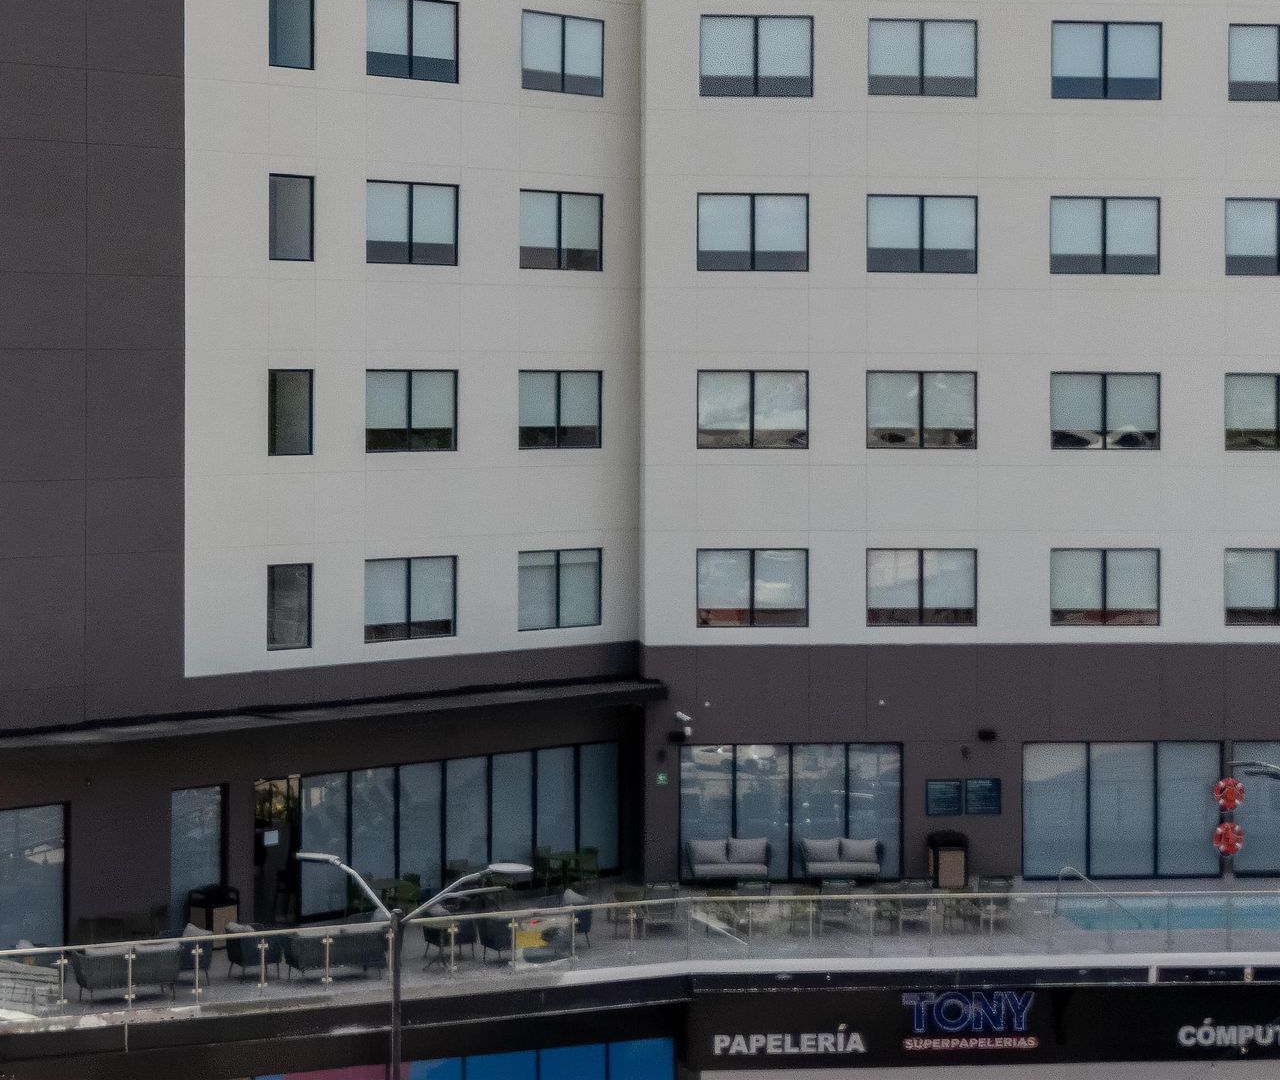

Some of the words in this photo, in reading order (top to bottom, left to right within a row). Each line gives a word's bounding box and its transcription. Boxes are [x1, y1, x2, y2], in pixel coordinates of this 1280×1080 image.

[902, 991, 1036, 1032] TONY
[713, 1023, 867, 1055] PAPELERÍA
[904, 1036, 1038, 1051] SUPERPAPELERIAS
